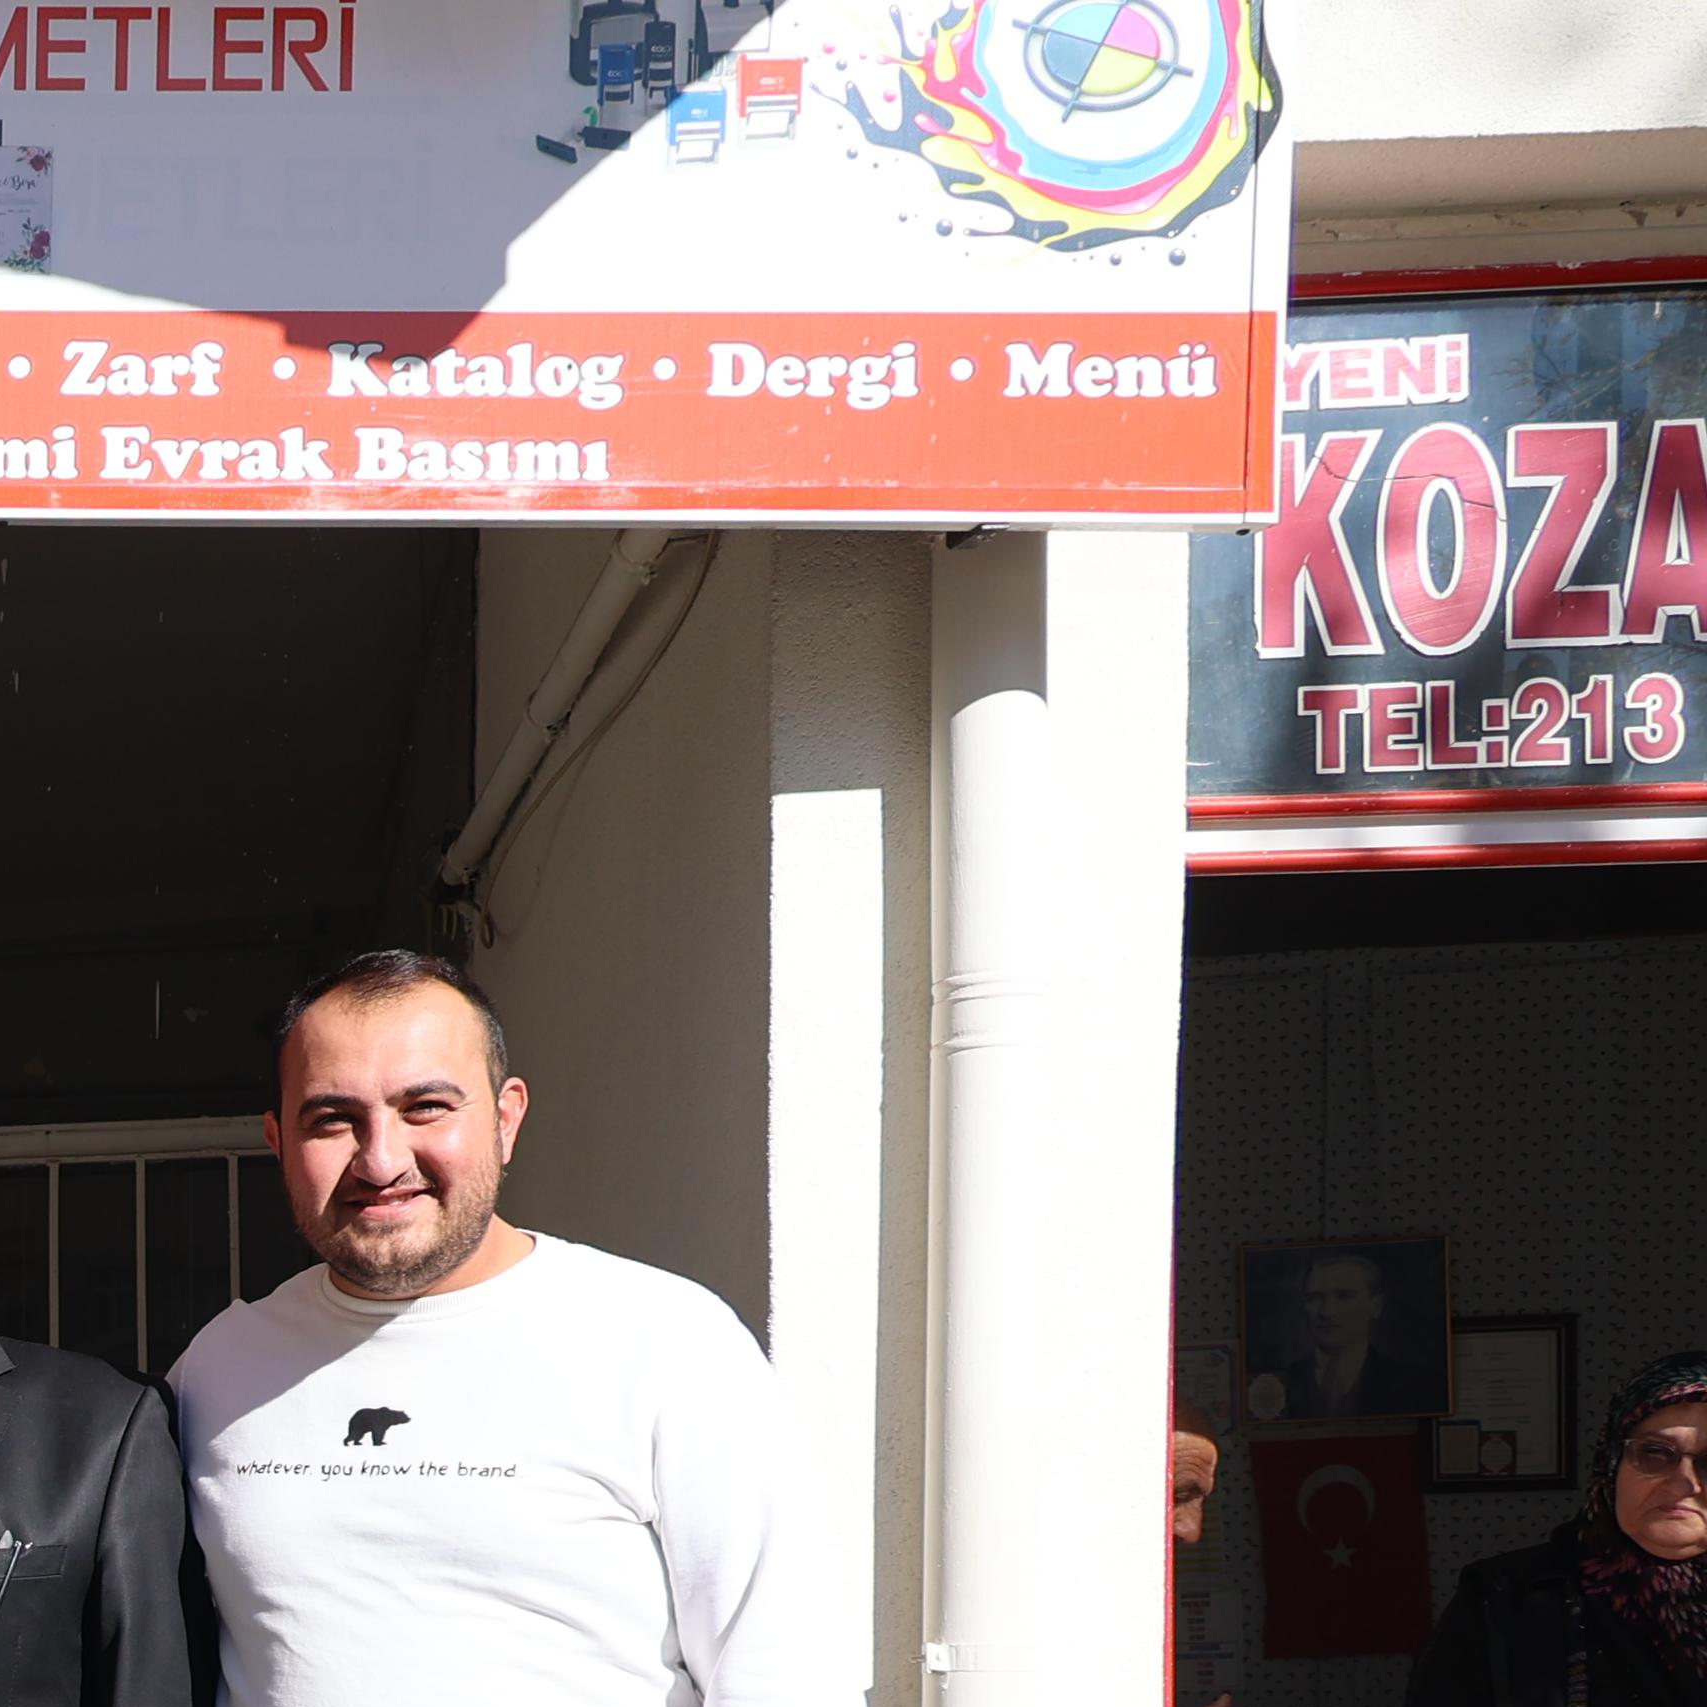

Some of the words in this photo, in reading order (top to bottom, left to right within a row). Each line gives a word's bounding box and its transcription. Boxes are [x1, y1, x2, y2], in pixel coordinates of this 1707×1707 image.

[61, 340, 225, 397] Zarf
[327, 342, 626, 410] Katalog
[706, 340, 919, 409] Dergi
[1003, 341, 1218, 398] Menü
[101, 426, 333, 481] Evrak
[353, 427, 610, 481] Basımı
[321, 1464, 353, 1481] you
[361, 1460, 412, 1477] know
[419, 1461, 448, 1476] the
